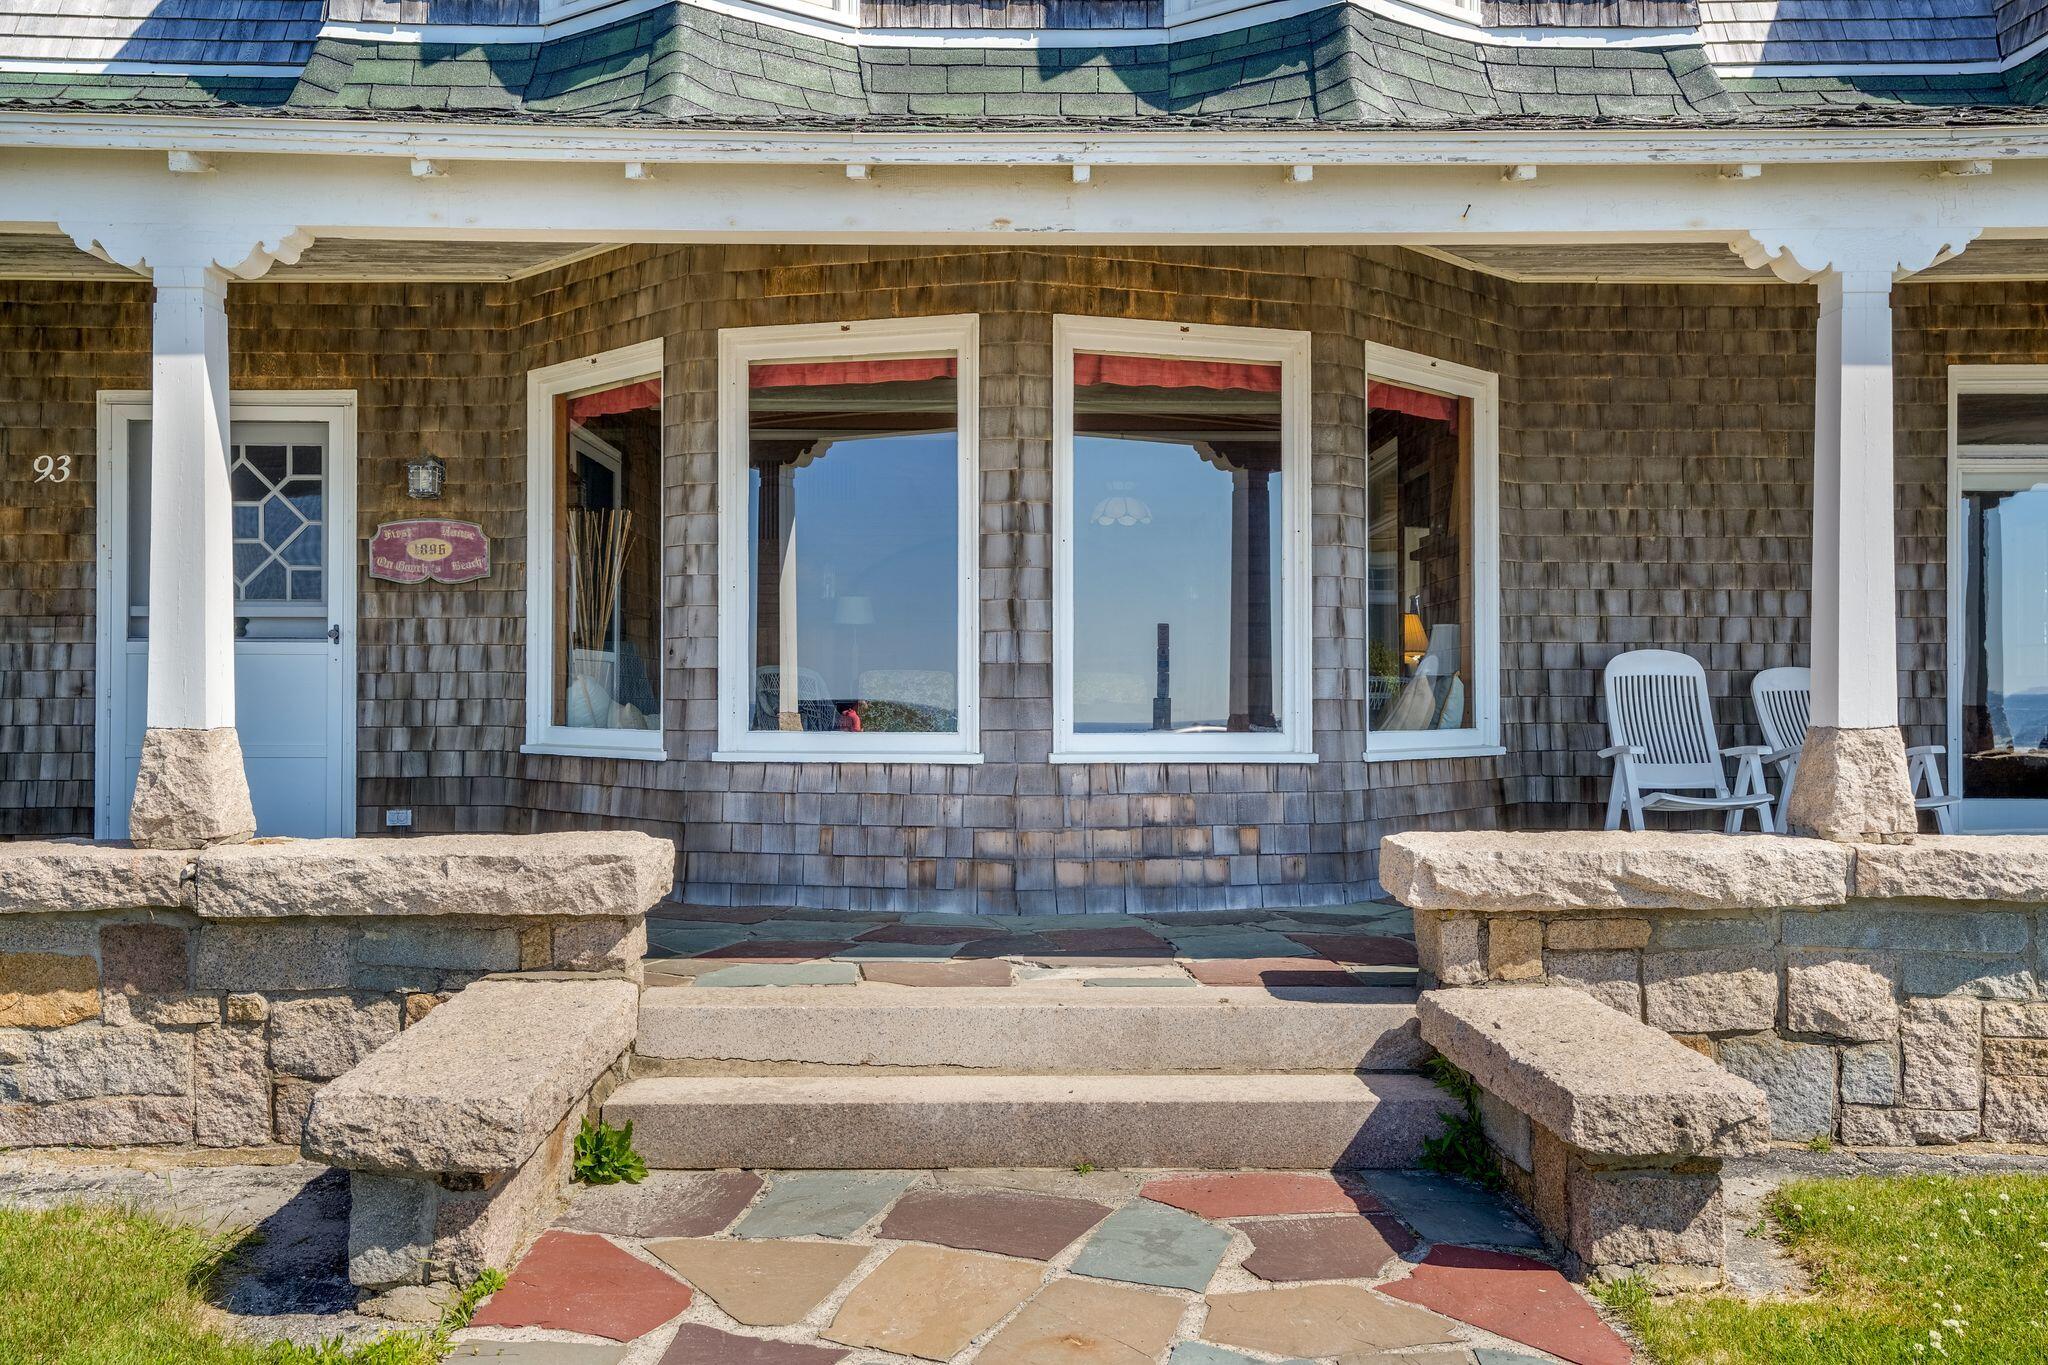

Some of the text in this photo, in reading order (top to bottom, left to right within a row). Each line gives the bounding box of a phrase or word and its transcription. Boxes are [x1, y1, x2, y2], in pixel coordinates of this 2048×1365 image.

[33, 455, 71, 483] 93
[376, 556, 393, 569] On
[451, 559, 483, 571] Beach
